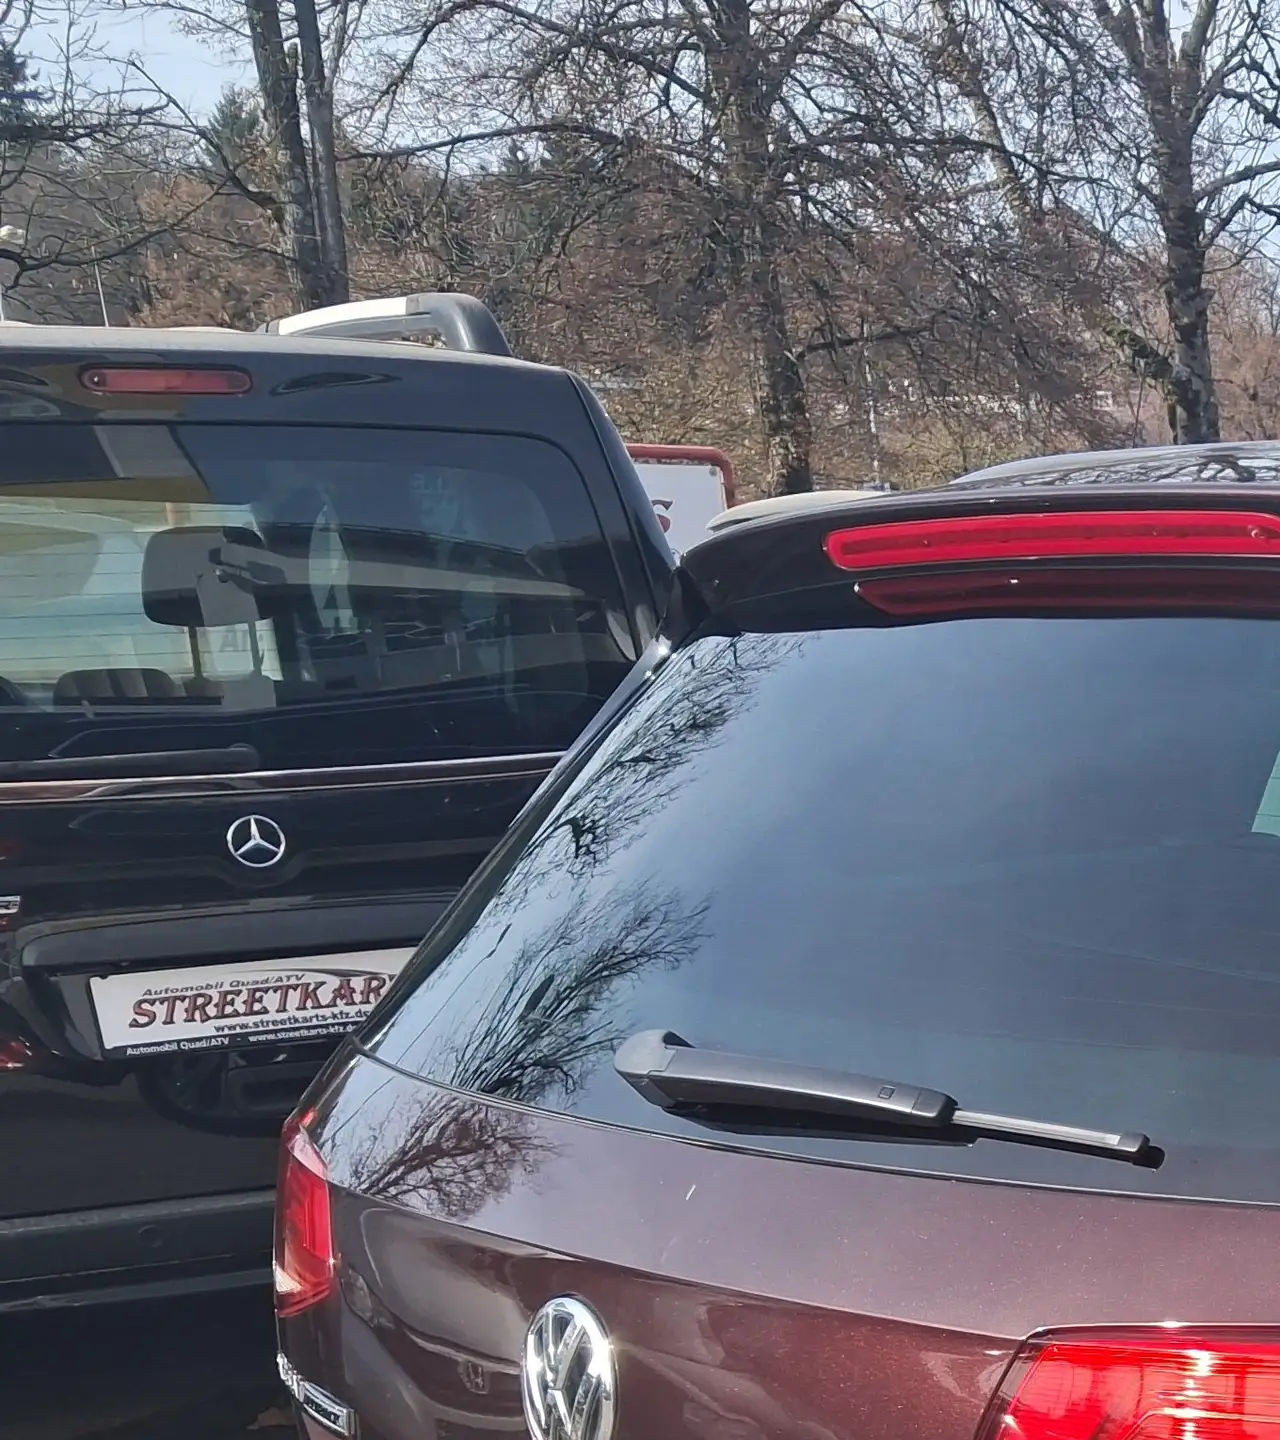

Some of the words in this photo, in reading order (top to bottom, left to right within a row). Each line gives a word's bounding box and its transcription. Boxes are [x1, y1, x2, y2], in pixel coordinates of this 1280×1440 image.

[141, 980, 225, 997] Automobil
[229, 973, 307, 988] Quad/ATV
[127, 1041, 179, 1056] Automobil
[180, 1036, 230, 1050] Quad/ATV
